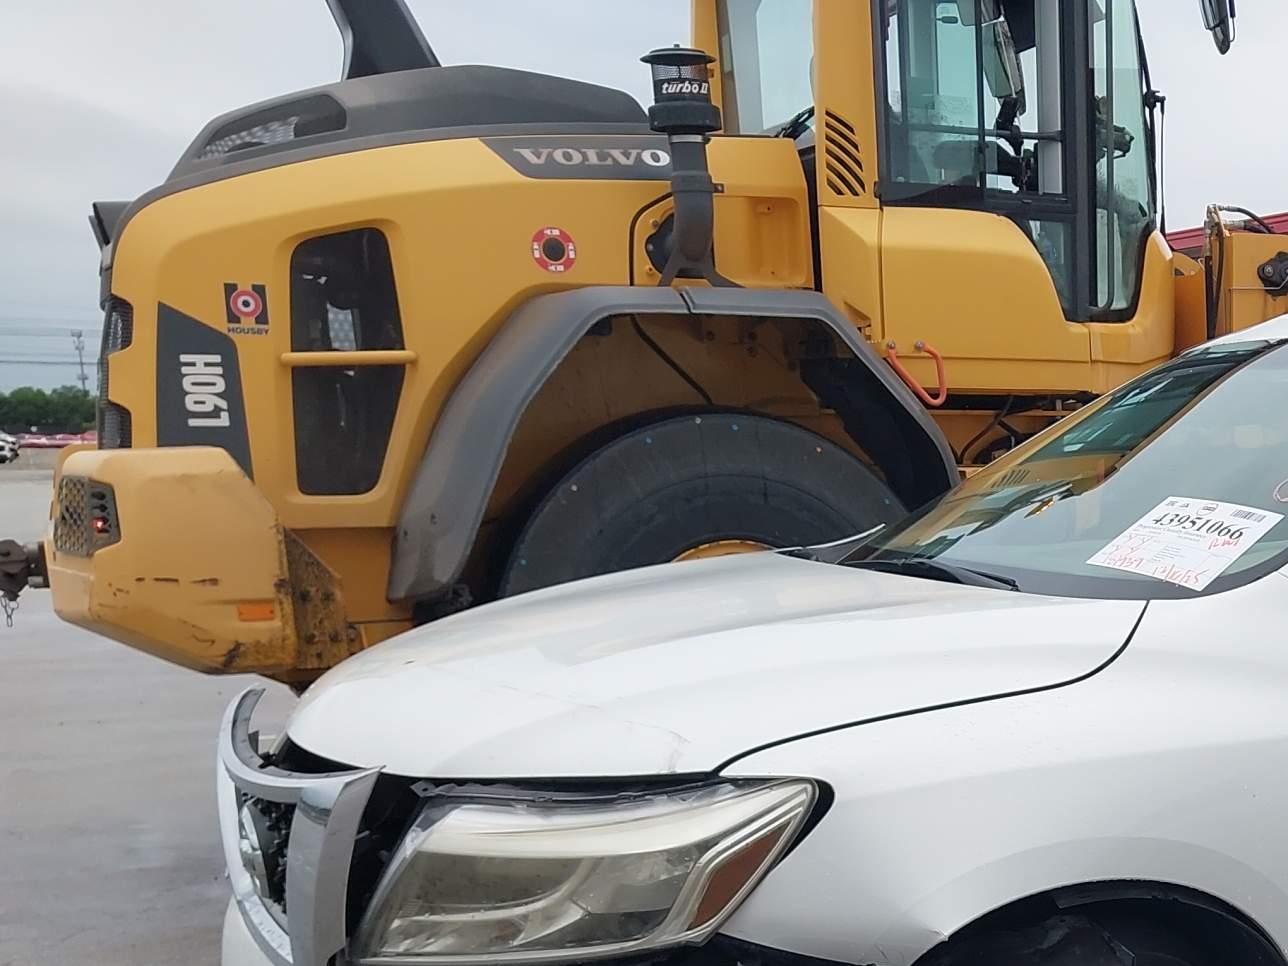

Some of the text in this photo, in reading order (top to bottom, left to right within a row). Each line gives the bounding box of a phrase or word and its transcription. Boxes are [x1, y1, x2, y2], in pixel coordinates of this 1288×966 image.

[513, 148, 670, 167] VOLVO
[227, 326, 270, 336] HOUSBY
[1152, 512, 1250, 540] 43951066
